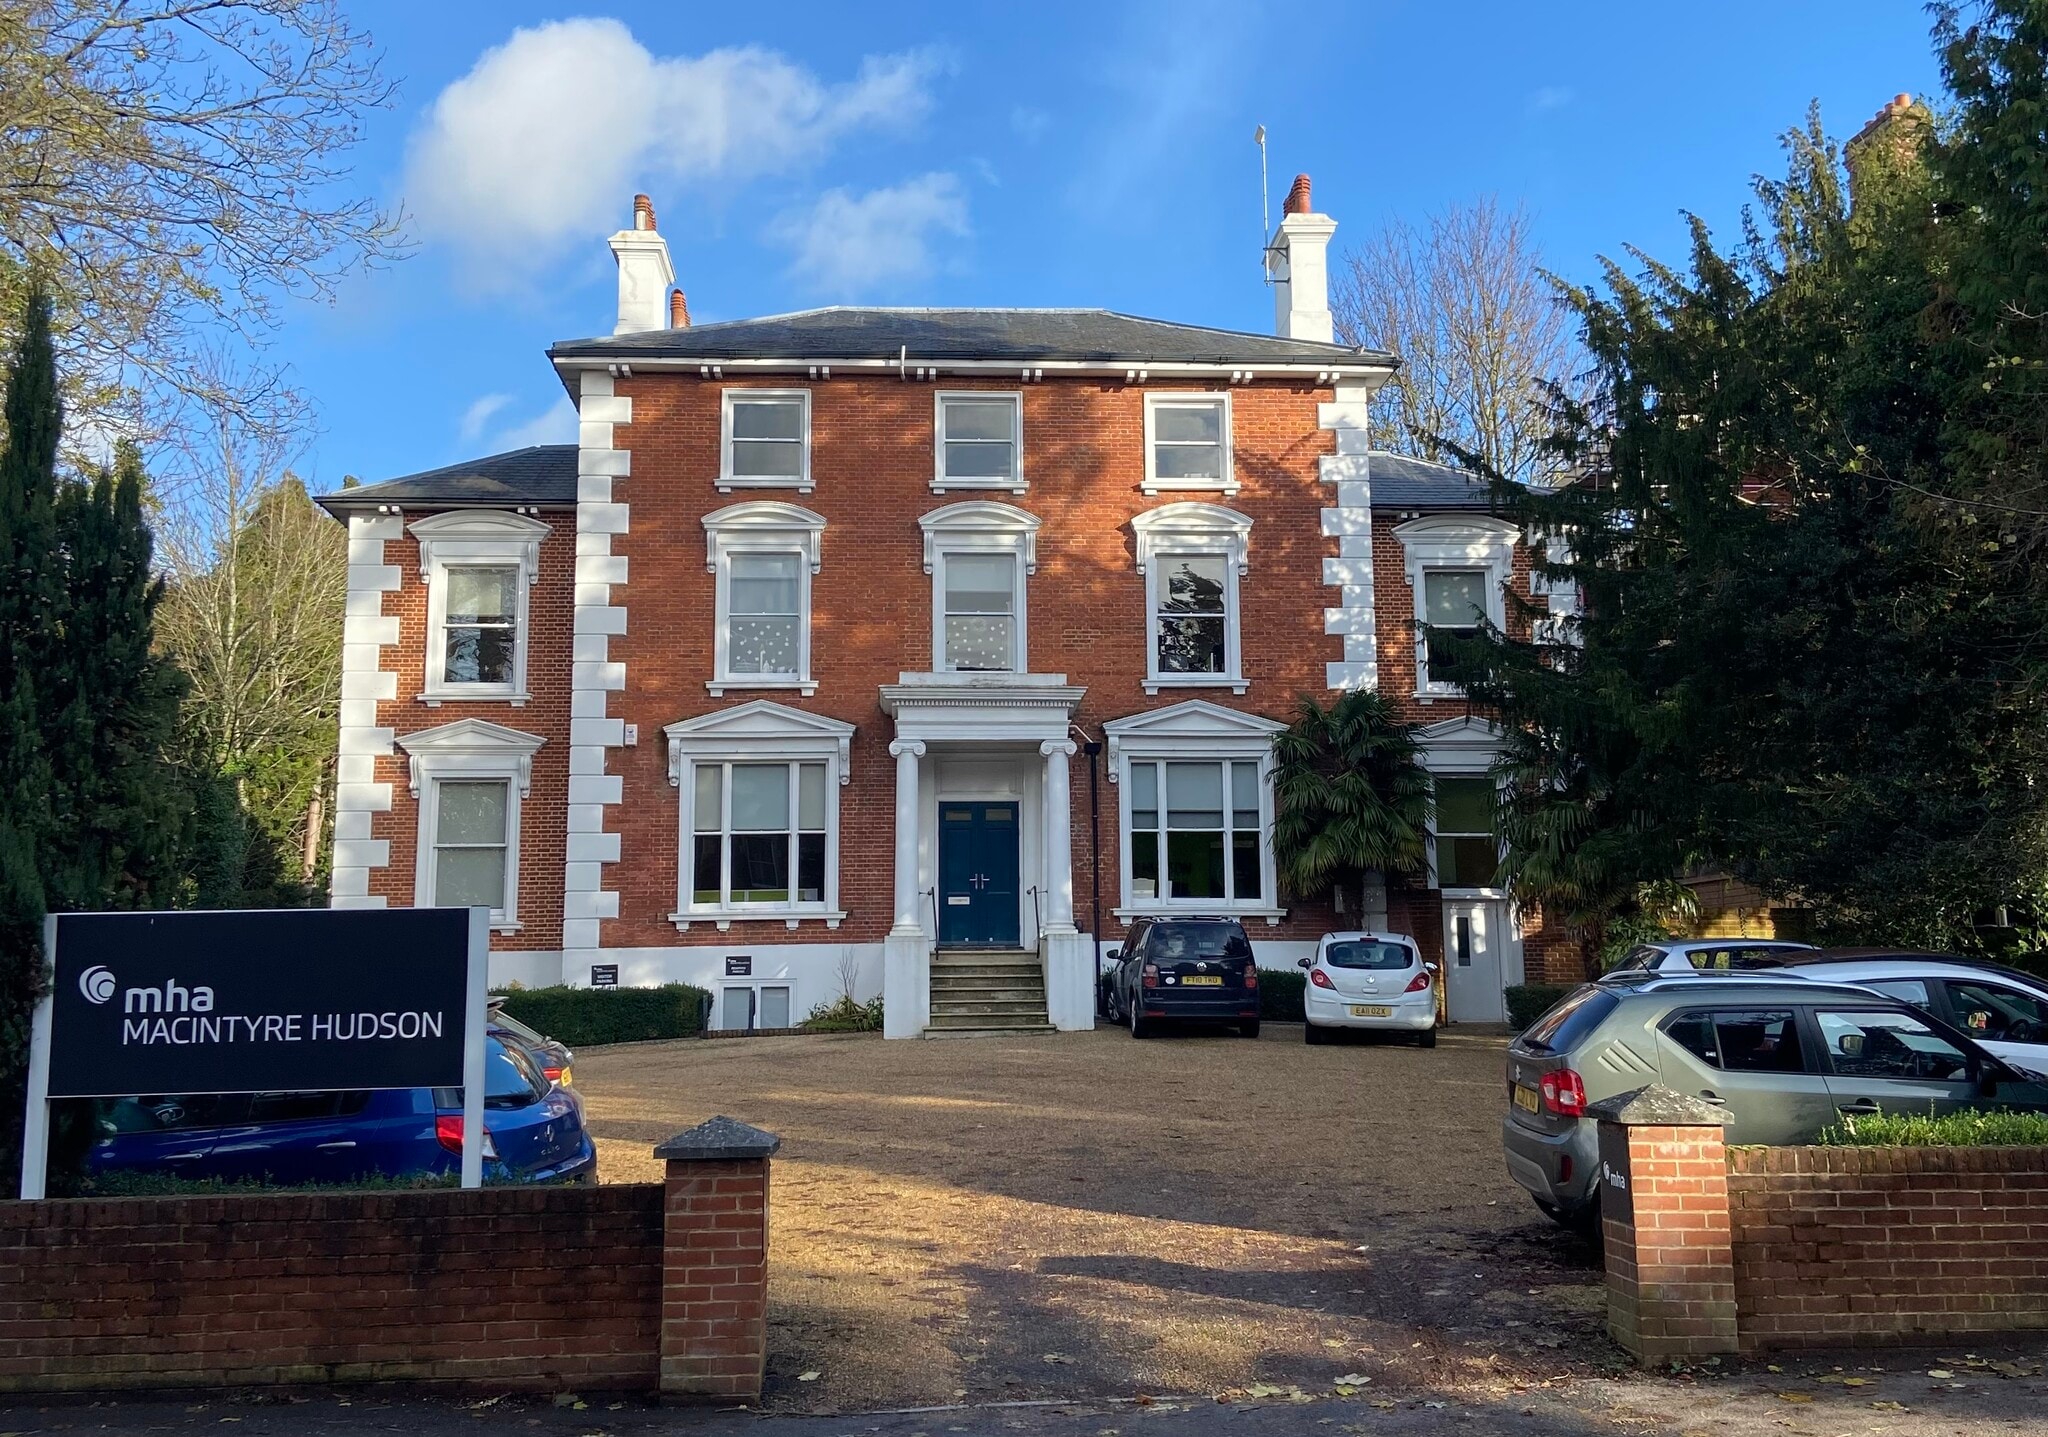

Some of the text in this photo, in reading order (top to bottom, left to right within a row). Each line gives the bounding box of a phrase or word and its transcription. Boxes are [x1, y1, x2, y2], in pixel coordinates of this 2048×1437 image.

[125, 978, 214, 1014] mha
[122, 1011, 443, 1046] MACINTYRE HUDSON
[1610, 1170, 1626, 1189] mha
